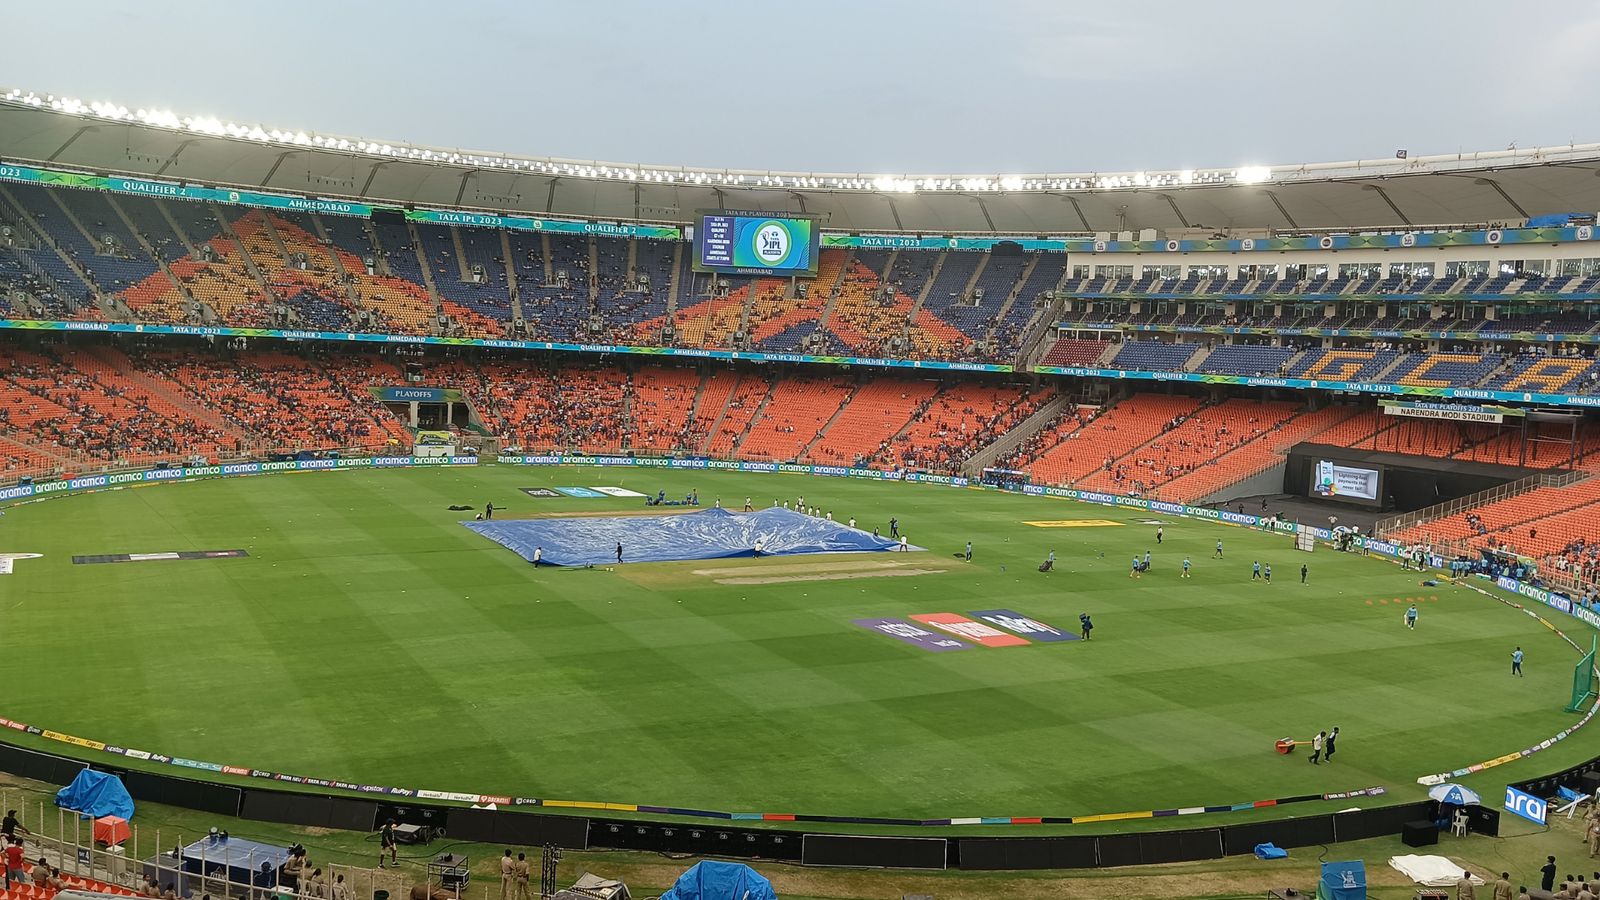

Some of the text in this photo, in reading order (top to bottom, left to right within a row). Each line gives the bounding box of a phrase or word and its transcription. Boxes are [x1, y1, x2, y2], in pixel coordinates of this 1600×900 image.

[122, 180, 186, 196] QUALIFIER 2
[288, 200, 351, 213] AHMEDABAD
[438, 212, 503, 225] TATA IPL 2023
[584, 224, 630, 234] QUALIFIER
[770, 241, 782, 249] IPL
[899, 239, 920, 247] 2023
[64, 322, 108, 331] AHMEDABAD
[1303, 350, 1596, 394] G C A
[1248, 378, 1287, 386] AHMEDABAD
[395, 390, 432, 399] PLAYOFFS
[1454, 389, 1488, 398] QUALIFIER
[1439, 403, 1467, 411] PLAYOFFS
[1400, 408, 1496, 421] NARENDRA MODI STADIUM
[261, 461, 296, 470] aramco
[300, 458, 334, 467] aramco
[338, 457, 371, 466] aramco
[186, 466, 219, 476] aramco
[224, 464, 258, 472] aramco
[814, 466, 845, 474] aramco
[849, 468, 881, 476] aramco
[109, 472, 142, 484] aramco
[146, 469, 181, 479] aramco
[919, 474, 949, 483] aramco
[36, 481, 68, 493] aramco
[72, 477, 105, 488] aramco
[0, 487, 32, 499] aramco
[1046, 487, 1077, 497] aramco
[1081, 492, 1112, 502] aramco
[1116, 497, 1147, 507] aramco
[1151, 501, 1183, 512] aramco
[1186, 506, 1218, 518] aramco
[1222, 512, 1255, 524] aramco
[1519, 584, 1547, 601] aramco
[391, 788, 412, 796] RuPay
